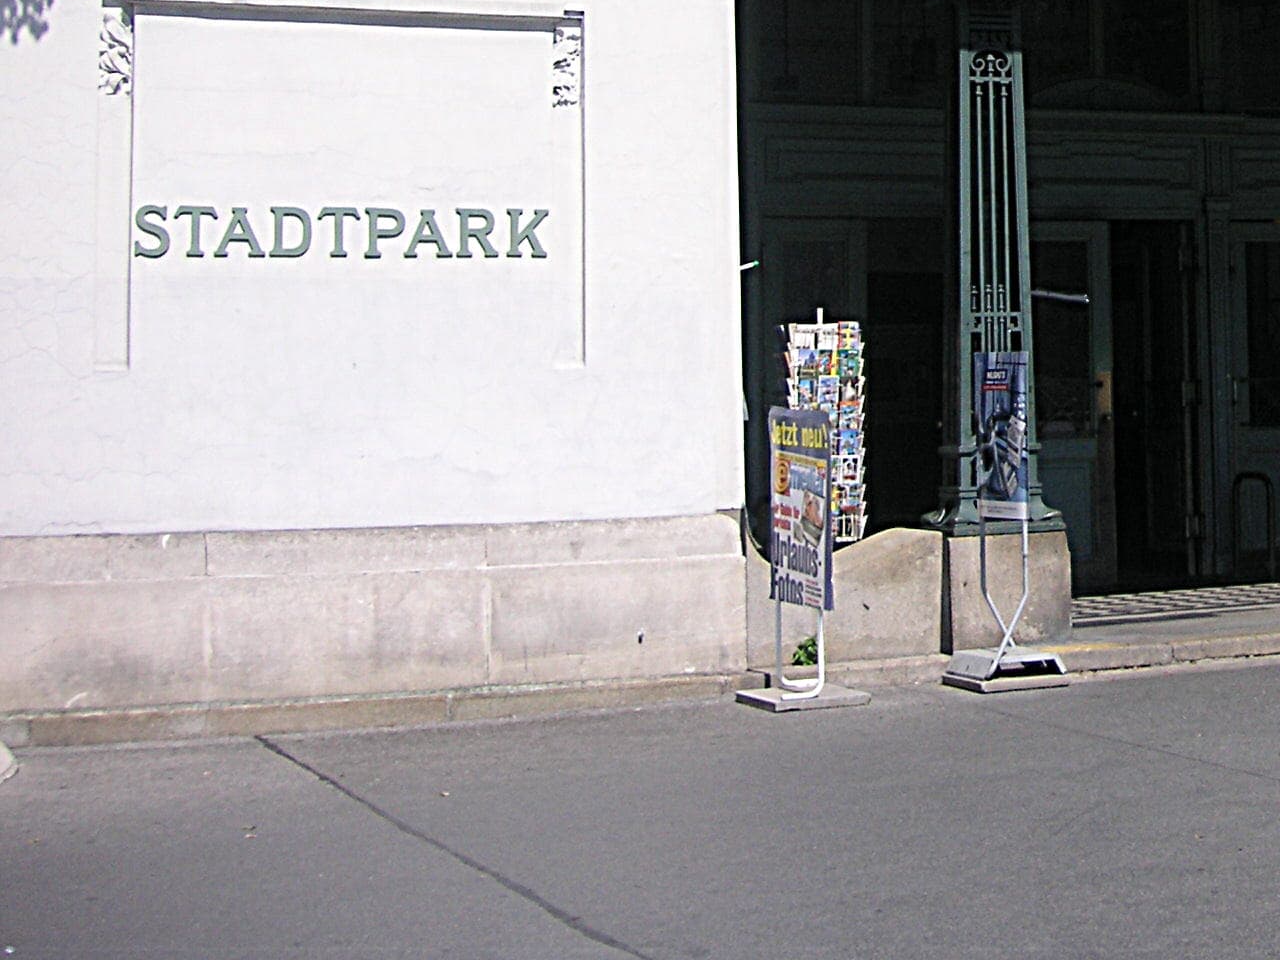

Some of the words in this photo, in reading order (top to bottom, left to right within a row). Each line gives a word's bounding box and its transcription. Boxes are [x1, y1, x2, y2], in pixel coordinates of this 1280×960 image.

[134, 205, 550, 259] STADTPARK
[771, 419, 798, 445] Jetzt
[769, 566, 804, 607] Fotos
